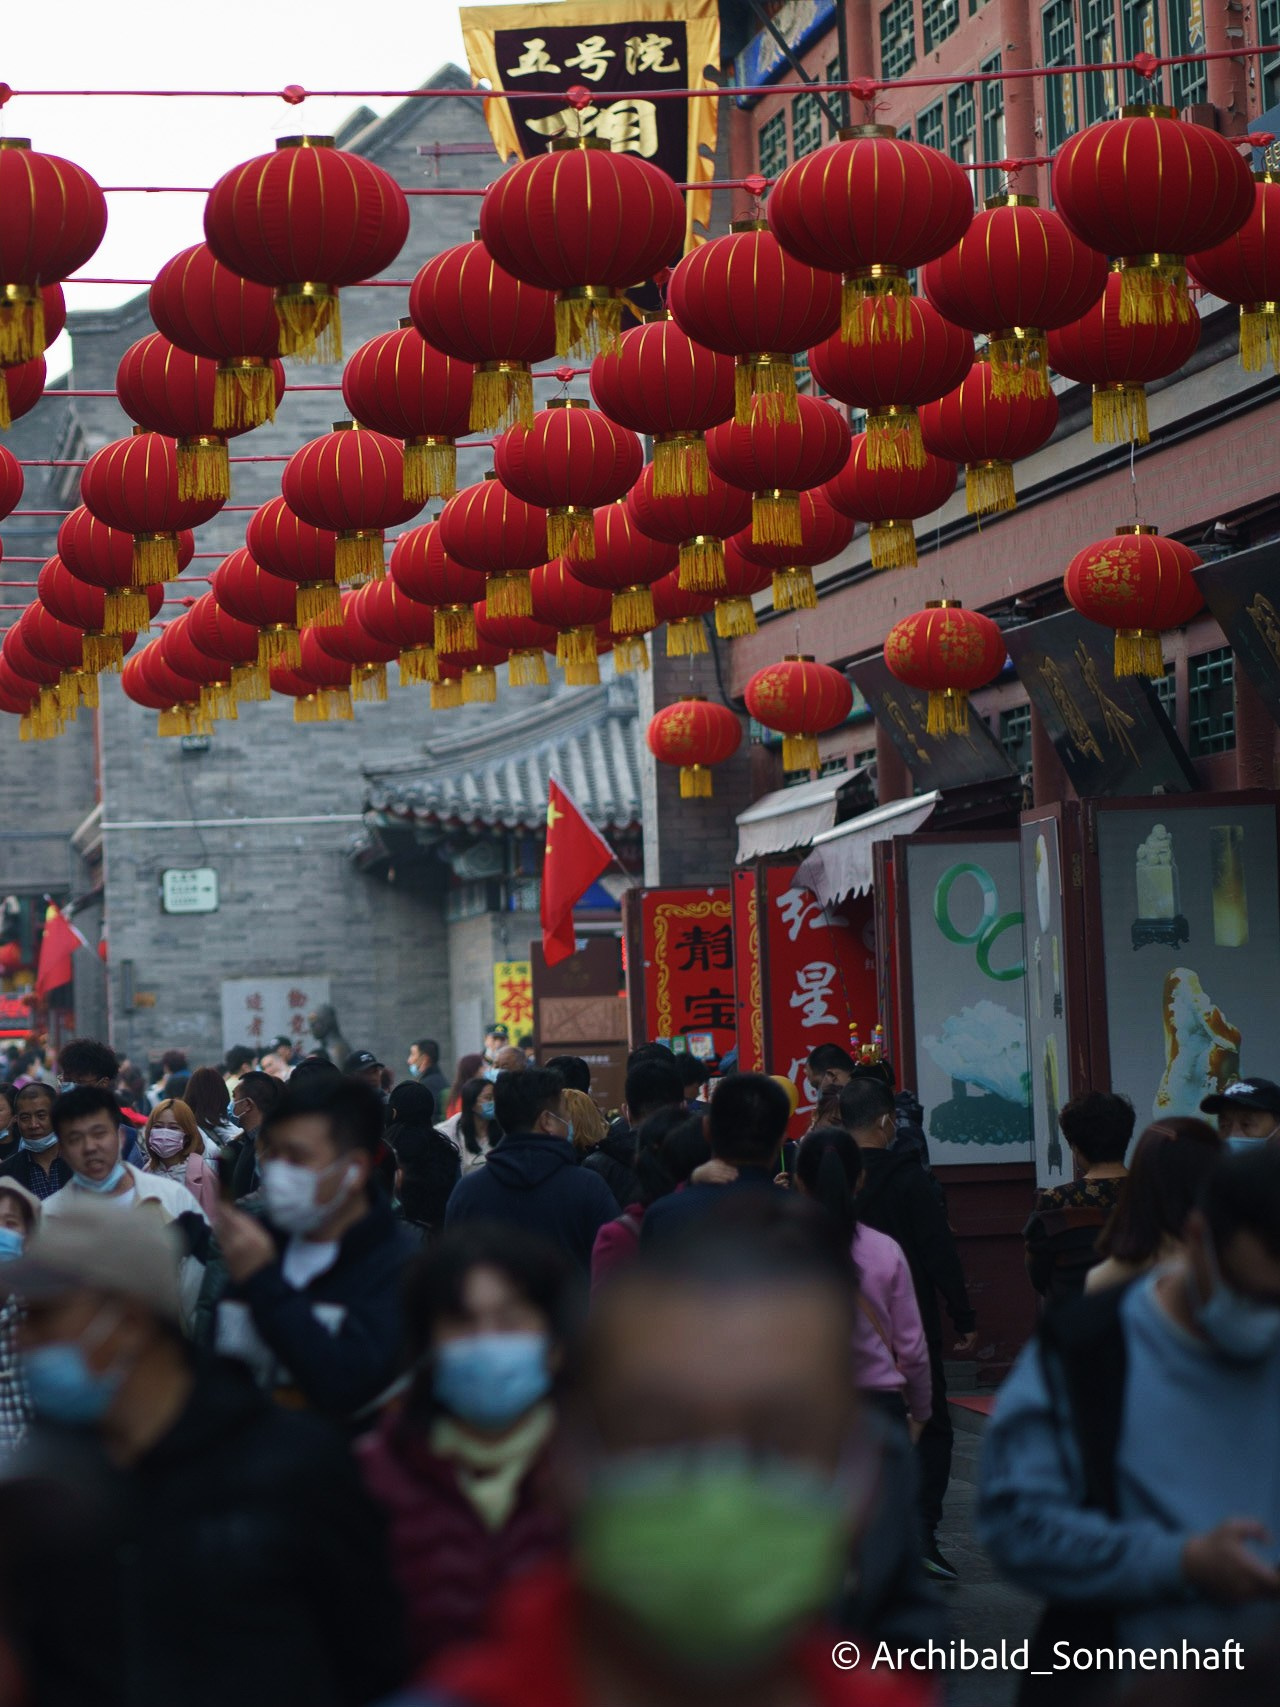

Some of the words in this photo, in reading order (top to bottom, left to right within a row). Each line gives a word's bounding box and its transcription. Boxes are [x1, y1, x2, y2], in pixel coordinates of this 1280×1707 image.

[506, 33, 681, 82] 五号院
[1087, 556, 1132, 581] 吉祥
[499, 978, 533, 1022] 茶
[674, 925, 736, 1077] 静宝
